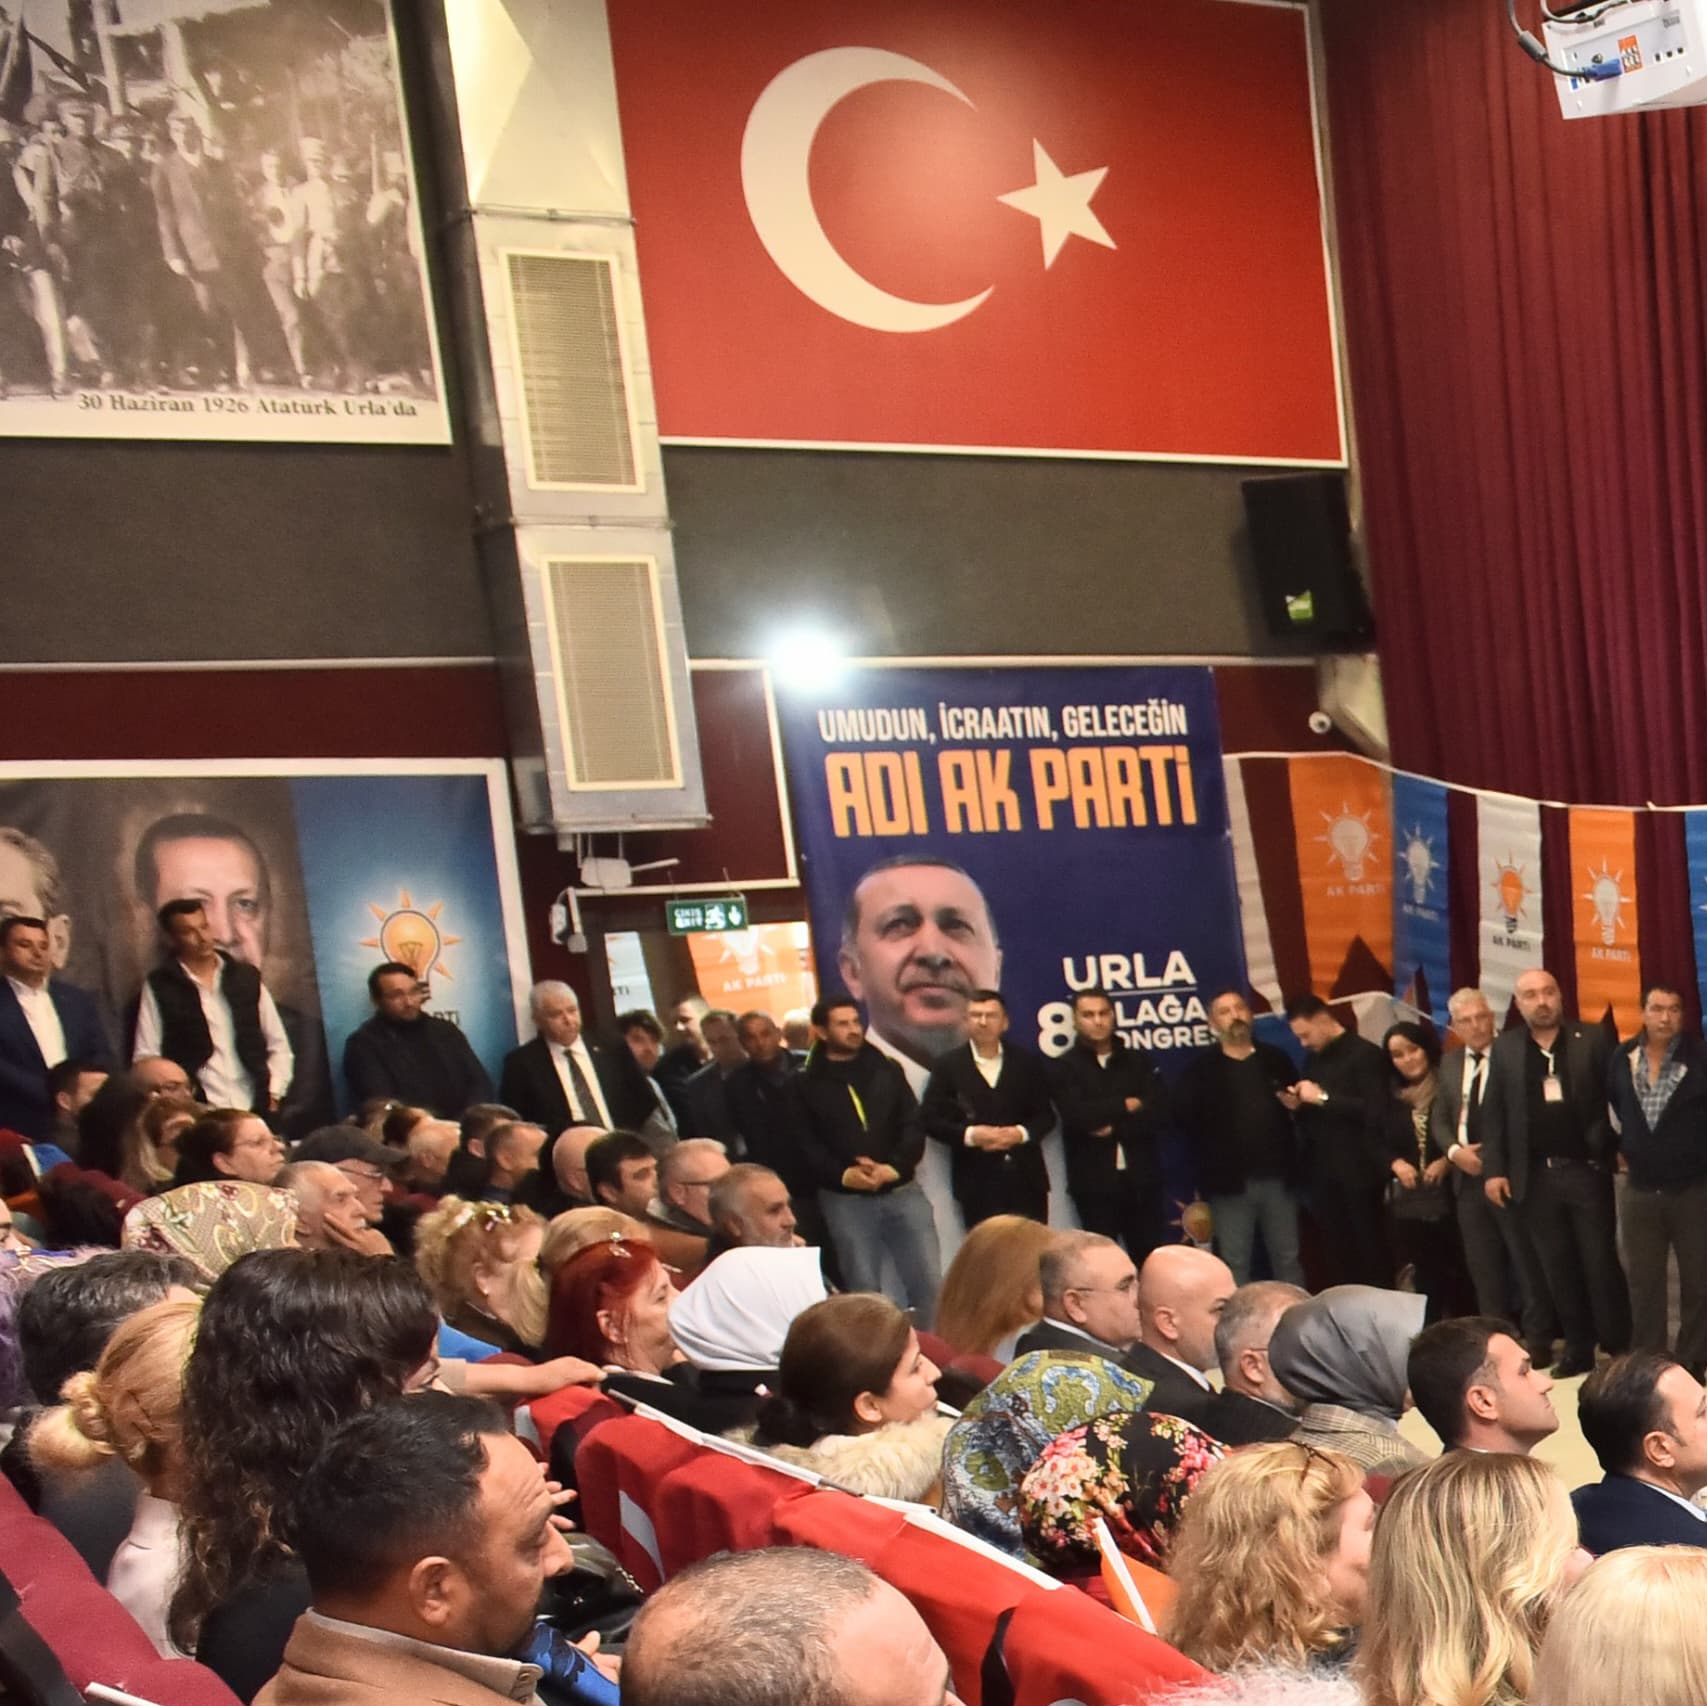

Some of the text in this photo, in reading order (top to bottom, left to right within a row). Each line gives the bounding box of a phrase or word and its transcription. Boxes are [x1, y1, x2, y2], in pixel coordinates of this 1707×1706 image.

[79, 393, 102, 410] 30
[110, 395, 195, 412] Haziran
[203, 397, 248, 413] 1926
[819, 699, 1187, 745] UMUDUN, İCRAATIN, GELECEĞİN
[825, 746, 1196, 837] ADI AK PARTİ
[1062, 950, 1197, 992] URLA
